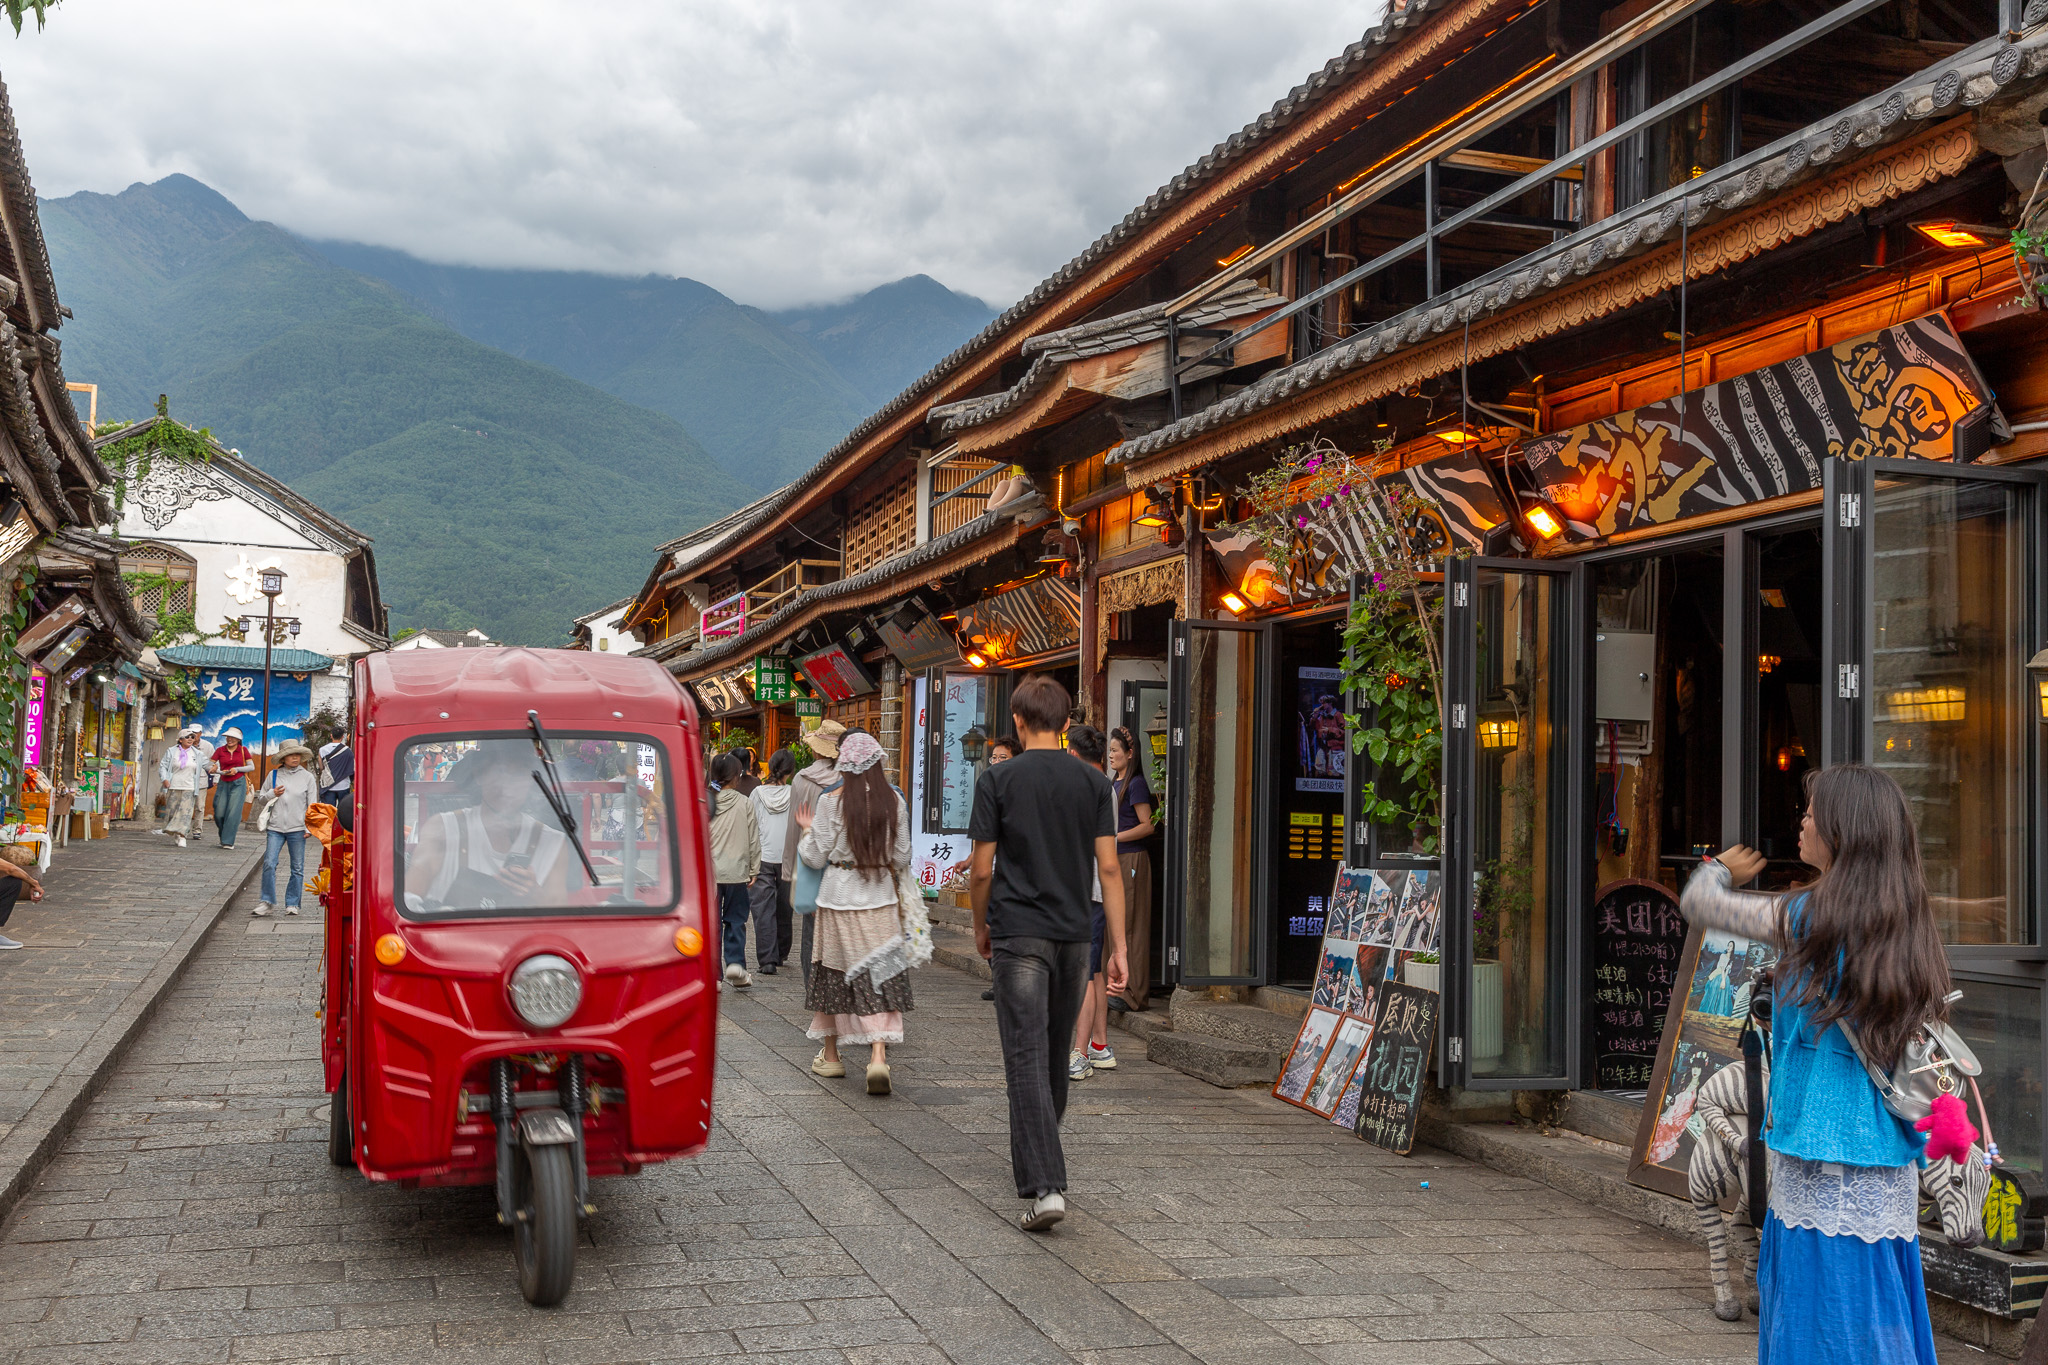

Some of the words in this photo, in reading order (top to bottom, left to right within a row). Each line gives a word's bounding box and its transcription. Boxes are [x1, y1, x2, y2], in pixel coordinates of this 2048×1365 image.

[761, 658, 786, 670] 网红
[203, 673, 255, 701] 大理
[761, 672, 786, 685] 屋顶
[761, 687, 786, 699] 打卡
[798, 702, 820, 713] 米饭
[1308, 896, 1332, 912] 美
[1289, 916, 1324, 936] 超级
[1598, 898, 1682, 936] 美团价
[1596, 963, 1627, 984] 啤酒
[1377, 992, 1420, 1044] 屋顶
[1603, 1009, 1644, 1028] 鸡尾酒
[1370, 1039, 1423, 1107] 花园
[1369, 1093, 1407, 1121] 打卡拍照
